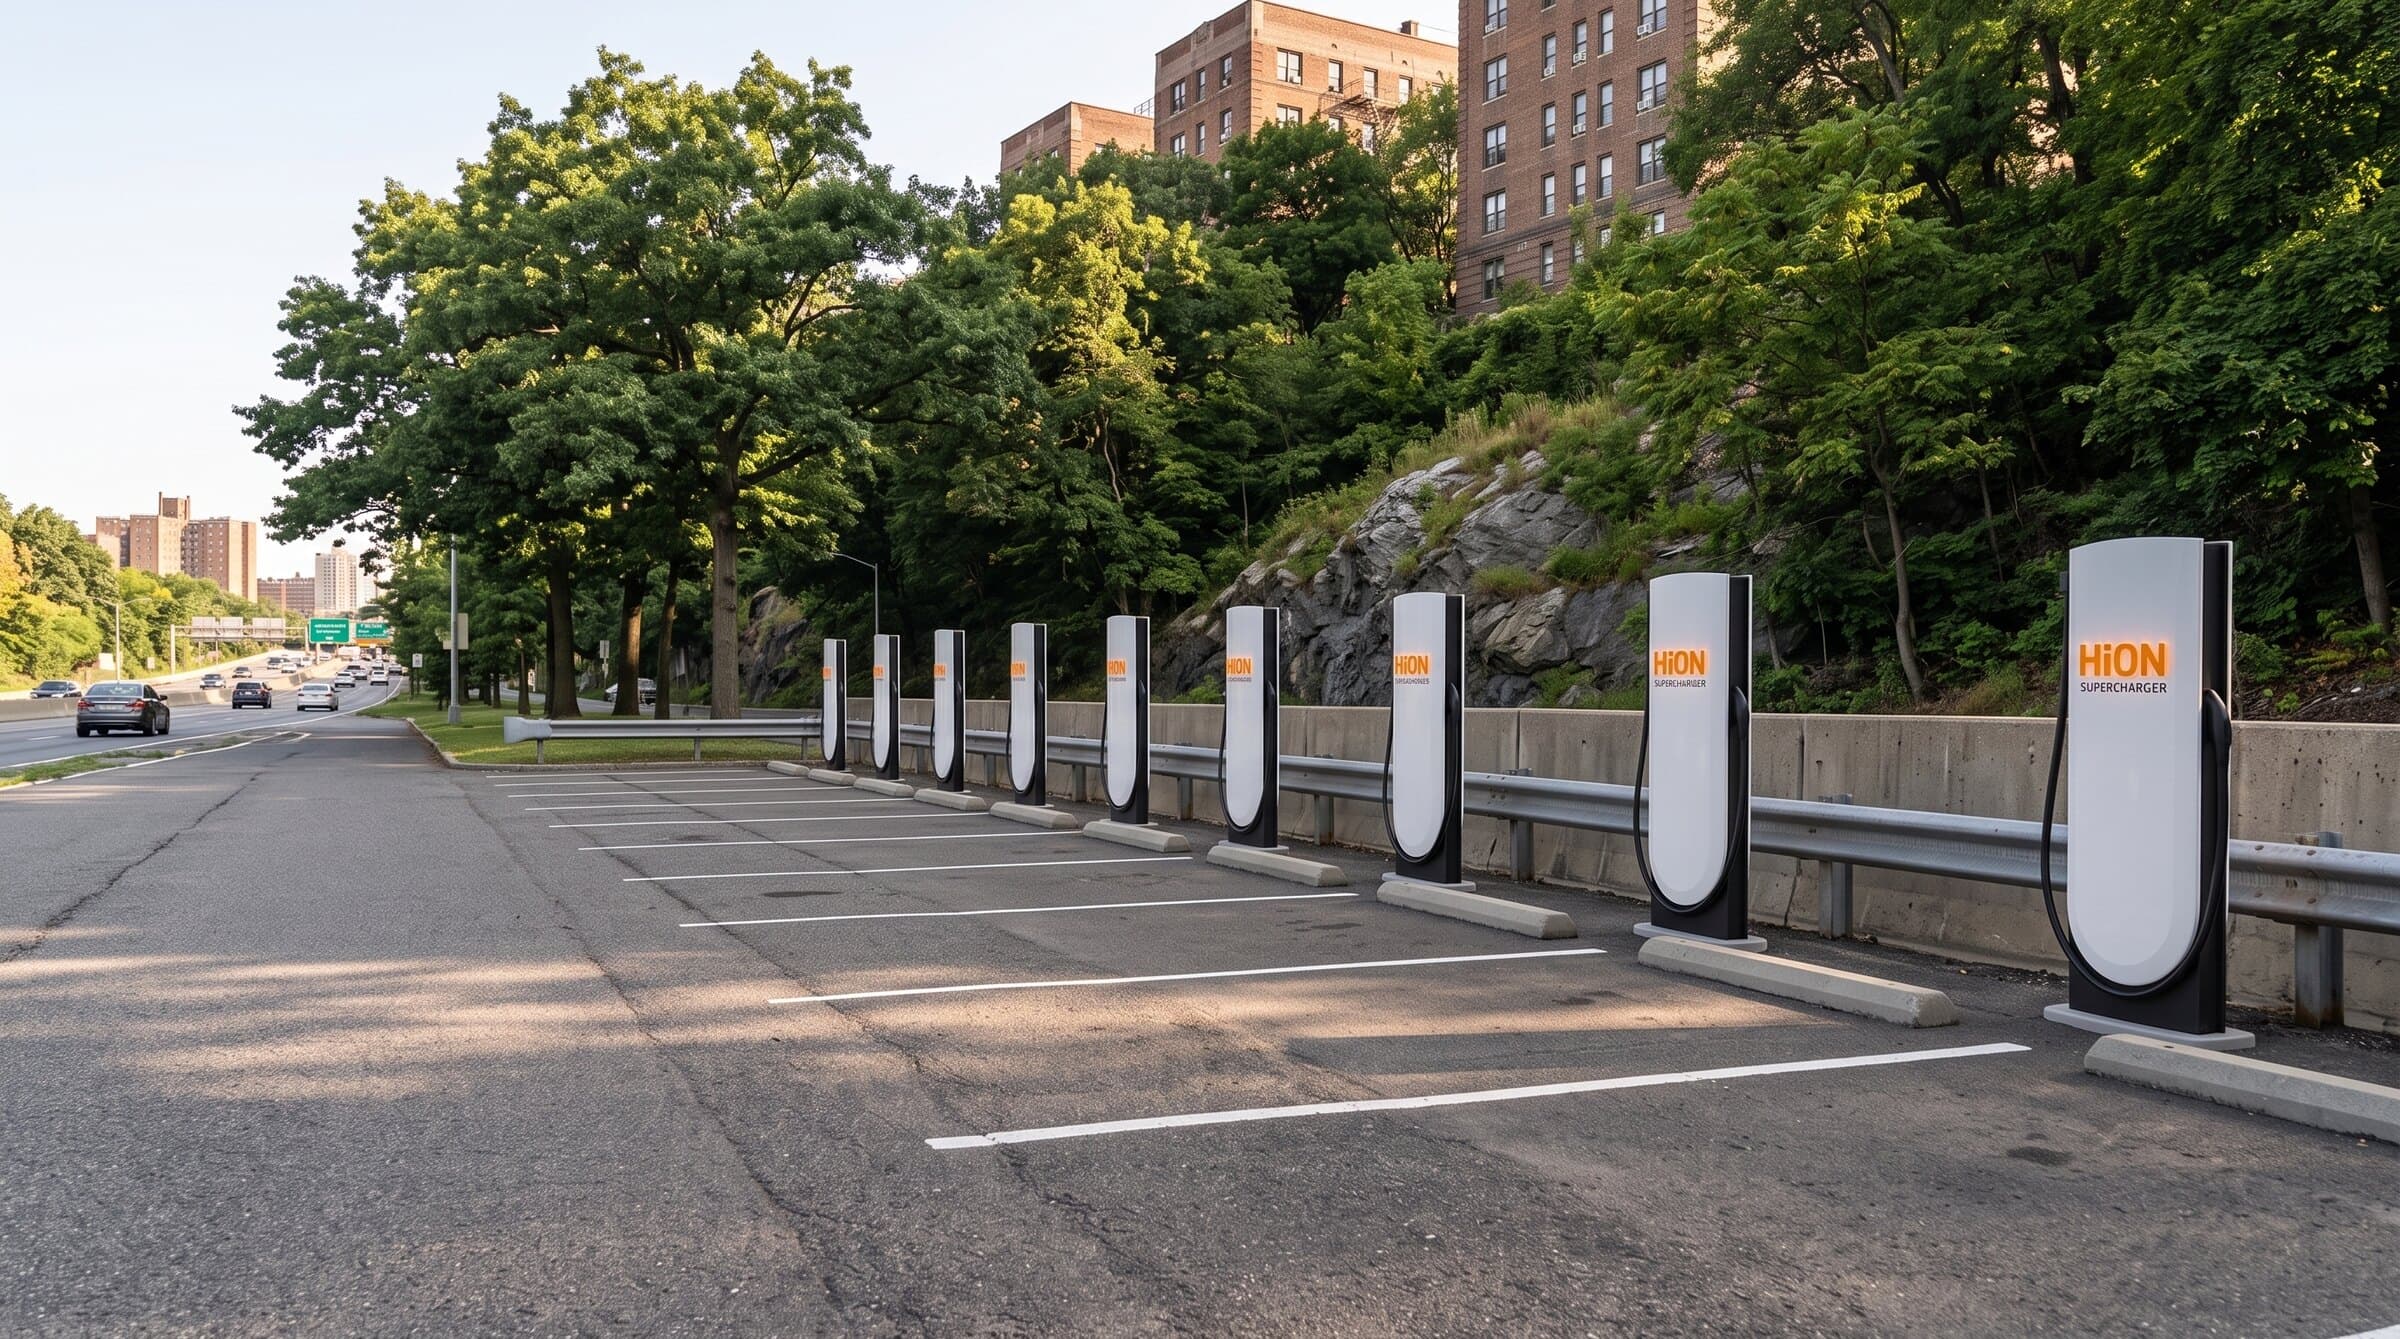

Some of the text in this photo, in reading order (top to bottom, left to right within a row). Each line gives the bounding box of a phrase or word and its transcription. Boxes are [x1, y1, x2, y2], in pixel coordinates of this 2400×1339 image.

[1394, 655, 1429, 675] HiON
[1654, 650, 1705, 676] HiON
[2079, 643, 2165, 677] HiON
[2080, 682, 2167, 693] SUPERCHARGER
